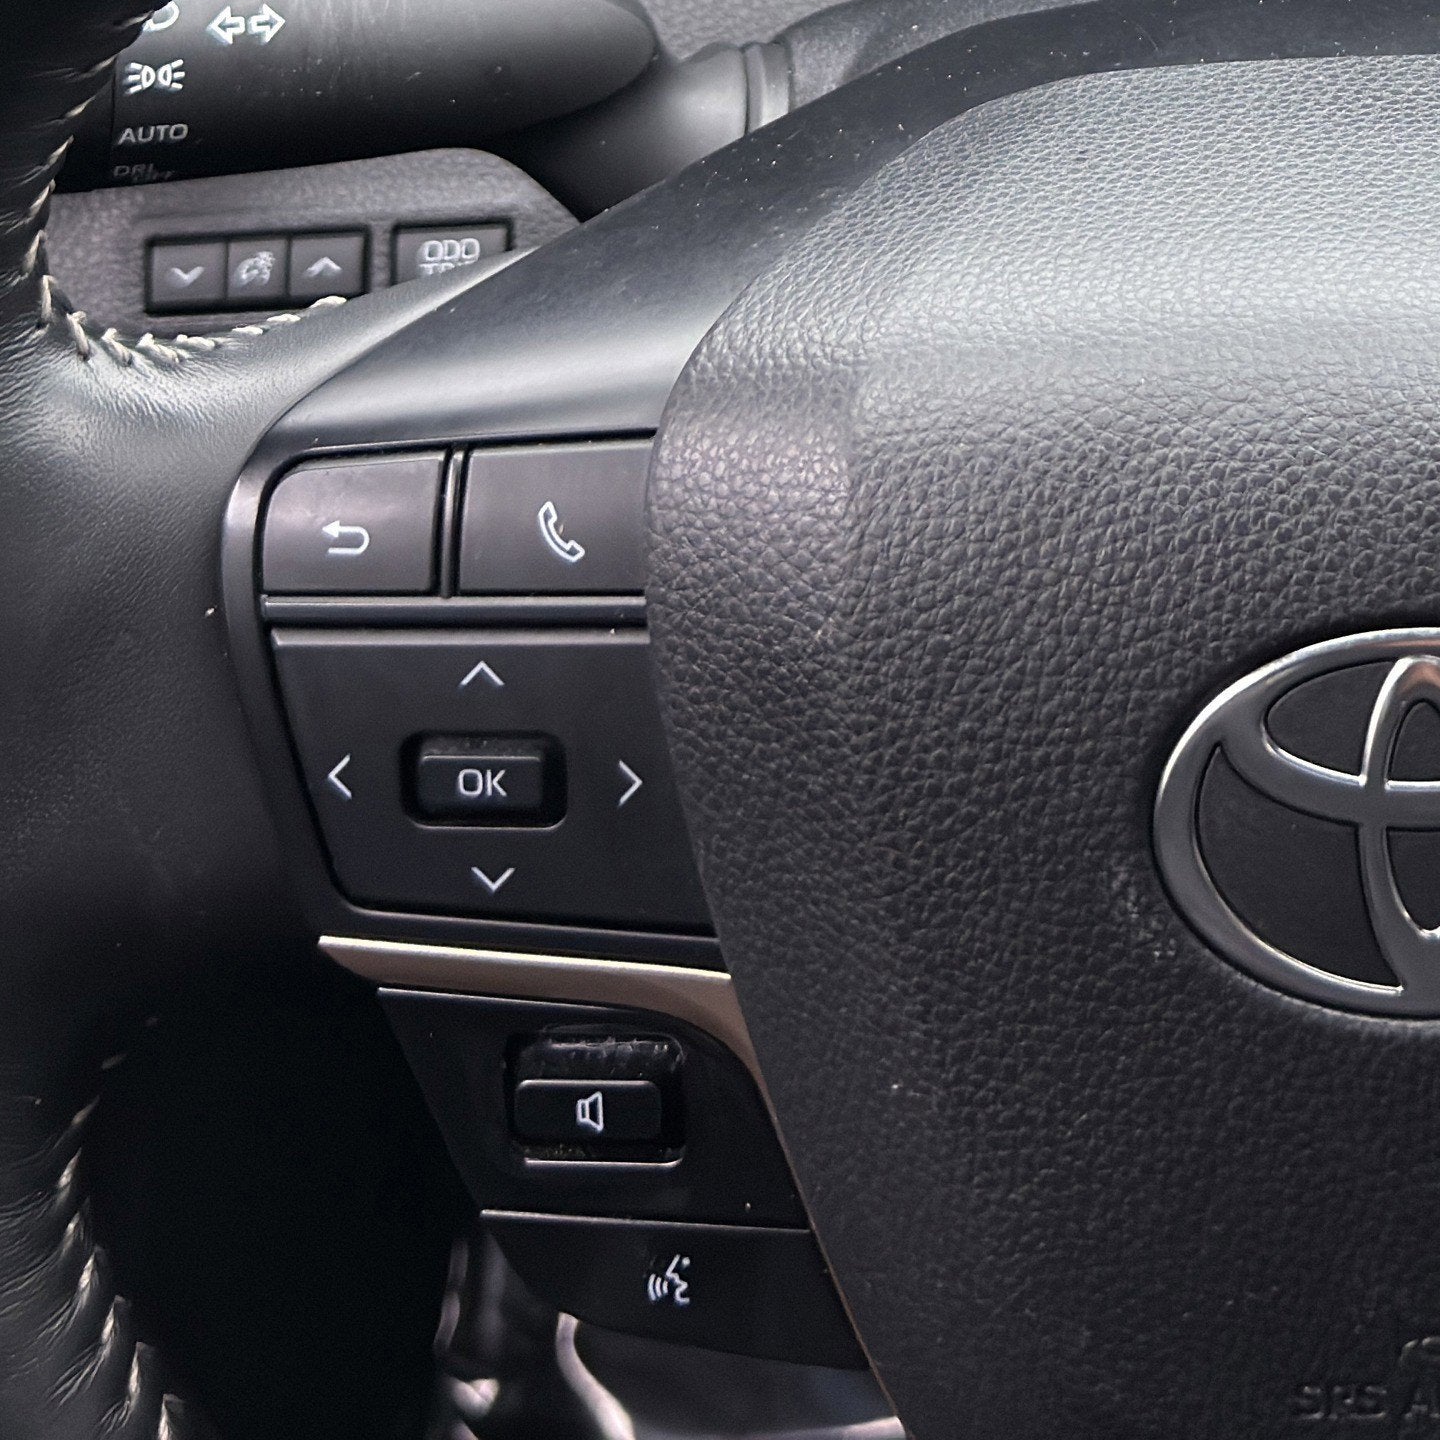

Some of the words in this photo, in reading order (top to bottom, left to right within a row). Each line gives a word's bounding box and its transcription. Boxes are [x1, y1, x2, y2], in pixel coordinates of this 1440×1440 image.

[117, 123, 189, 145] AUTO
[424, 238, 481, 261] ODO
[459, 769, 508, 797] OK
